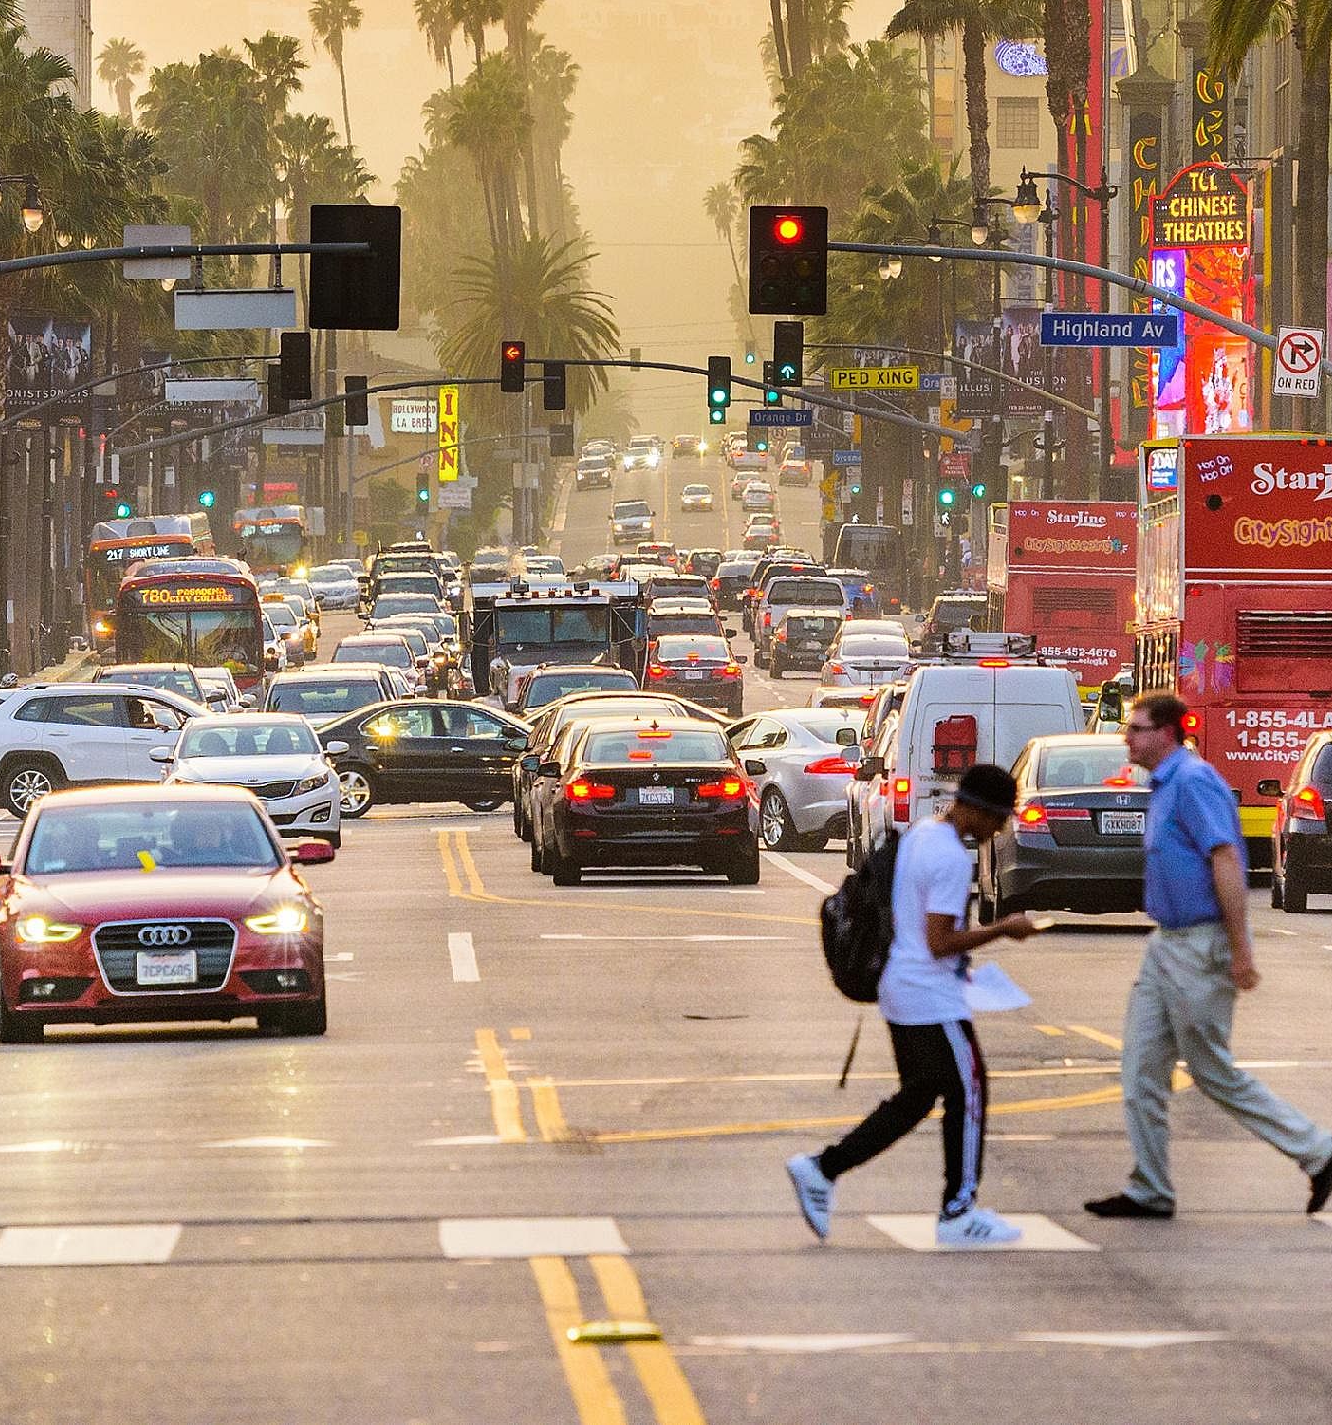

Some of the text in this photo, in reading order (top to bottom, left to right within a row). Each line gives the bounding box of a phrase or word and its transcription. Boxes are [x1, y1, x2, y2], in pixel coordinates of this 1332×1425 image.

[1189, 172, 1218, 192] TCL
[1170, 196, 1237, 218] CHINESE
[1163, 220, 1244, 242] THEATRES
[1053, 320, 1164, 342] Highland Av
[838, 370, 913, 385] PED XING
[1279, 376, 1315, 390] ON RED
[393, 405, 436, 414] HOLLYWOOD
[397, 418, 407, 428] LA
[754, 411, 807, 424] Orange Dr
[441, 394, 456, 470] INN
[139, 589, 170, 604] 780
[177, 587, 226, 596] PASADENA
[194, 594, 233, 602] COLLEGE
[1237, 730, 1307, 748] 1-855-
